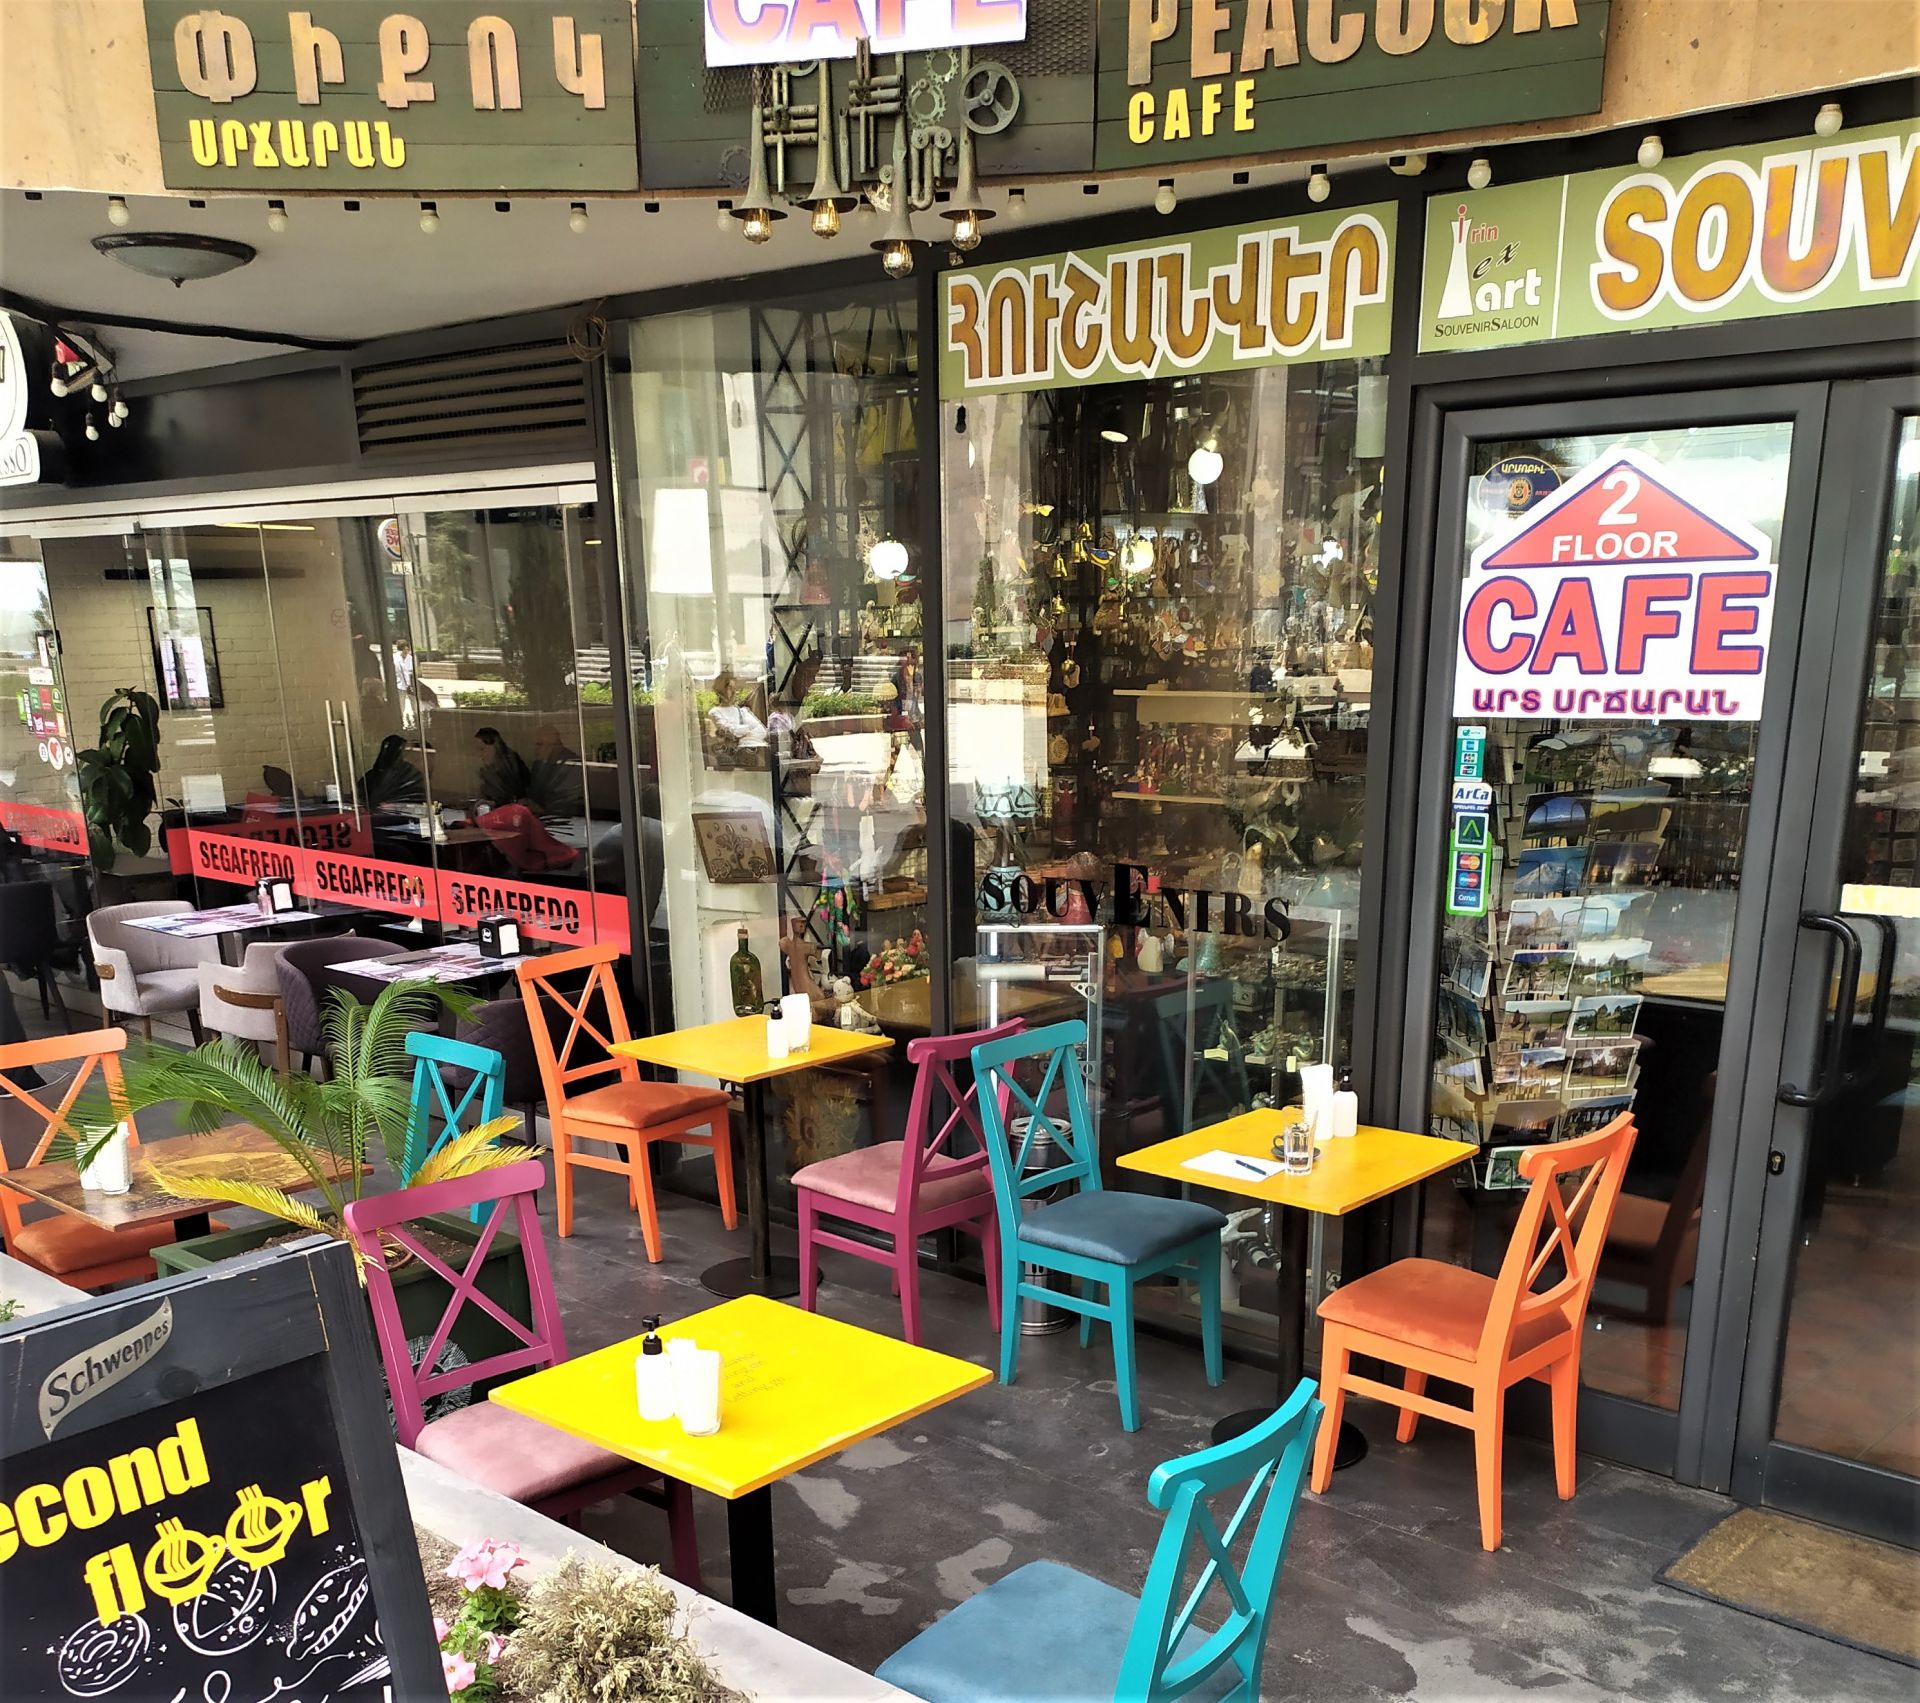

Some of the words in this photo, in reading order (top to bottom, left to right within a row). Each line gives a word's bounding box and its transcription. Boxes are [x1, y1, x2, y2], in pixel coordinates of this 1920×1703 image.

[174, 10, 607, 110] ՓԻՔՈԿ
[1127, 78, 1257, 145] CAFE
[188, 118, 407, 169] ՍՐՃԱՐԱՆ
[948, 222, 1382, 382] ՀՈՒՇԱՆՎԵՐ
[1598, 470, 1641, 526] 2
[1552, 530, 1679, 562] FLOOR
[1462, 571, 1772, 675] CAFE
[1472, 688, 1541, 714] ԱՐՏ
[1553, 688, 1740, 715] ՍՐՃԱՐԱՆ
[1454, 787, 1489, 800] ArCa
[200, 840, 295, 882] SEGAFREDO
[316, 860, 425, 908] SEGAFREDO
[451, 882, 580, 934] SEGAFREDO
[980, 862, 1292, 942] SOUVENIRS
[47, 1318, 170, 1417] Schweppes
